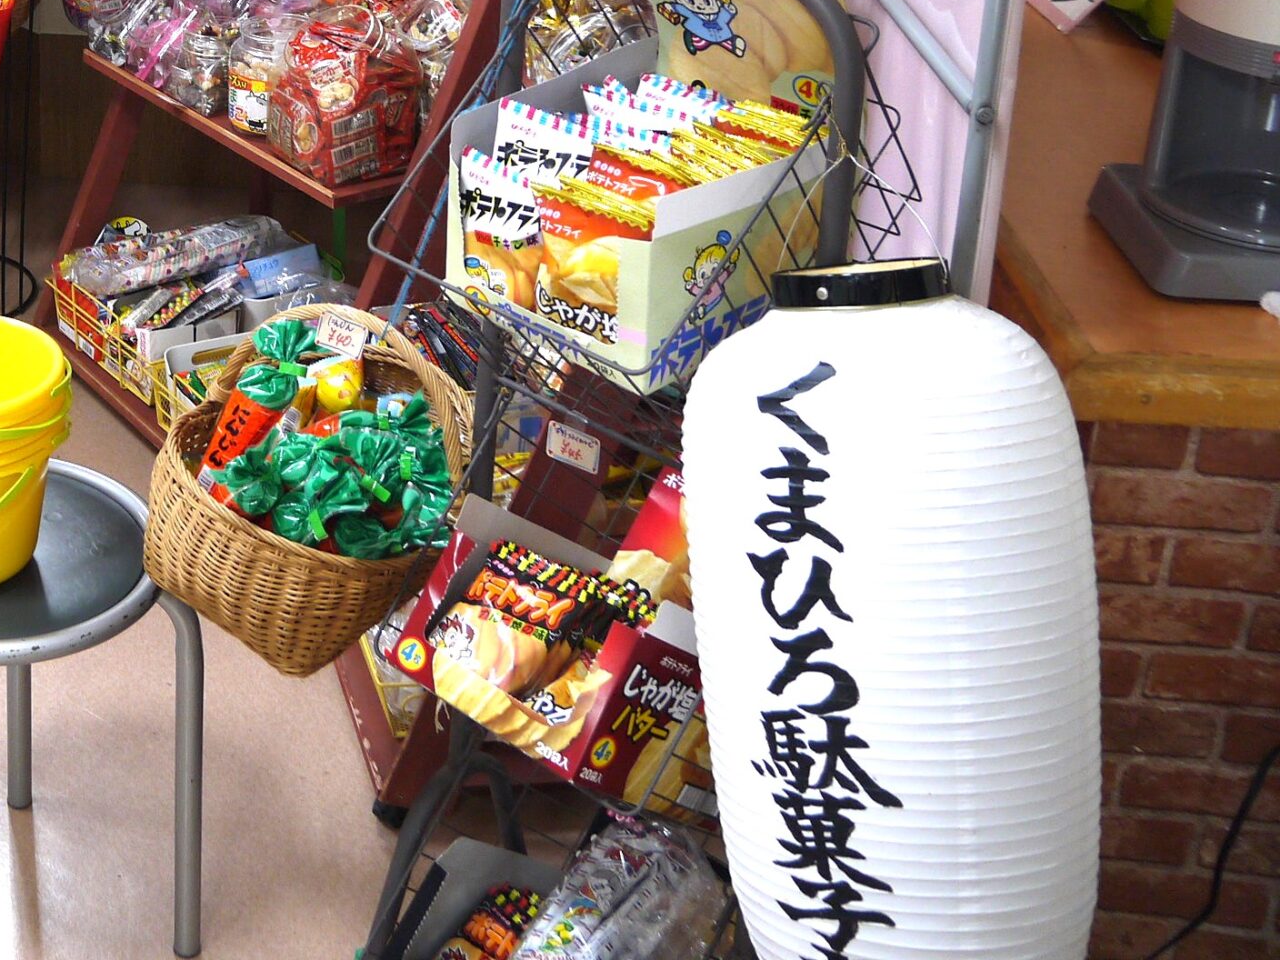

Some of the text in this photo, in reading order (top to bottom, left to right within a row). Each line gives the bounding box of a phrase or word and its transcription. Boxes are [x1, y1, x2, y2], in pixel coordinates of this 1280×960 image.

[467, 569, 574, 630] ポテトフライ
[747, 360, 903, 960] くまひろ駄菓子
[624, 663, 697, 722] じゃが塩
[612, 704, 670, 742] バター
